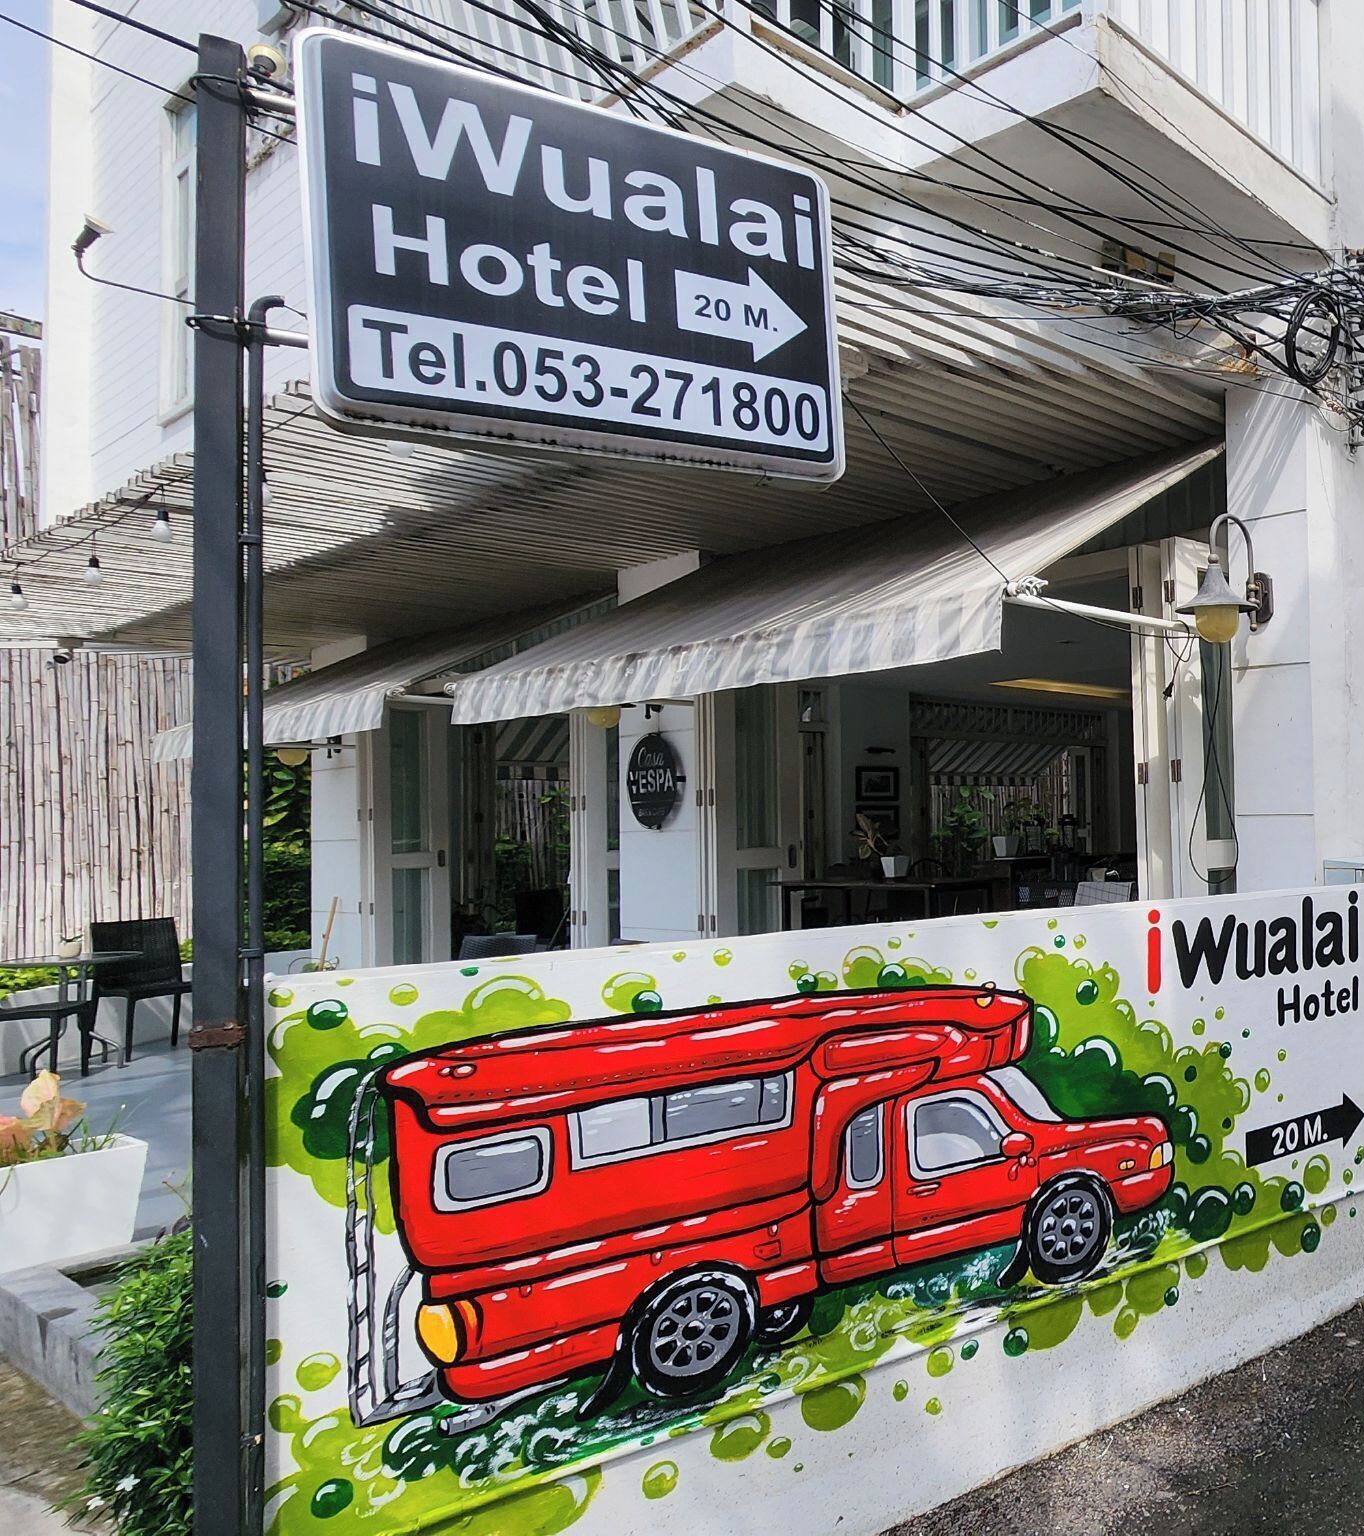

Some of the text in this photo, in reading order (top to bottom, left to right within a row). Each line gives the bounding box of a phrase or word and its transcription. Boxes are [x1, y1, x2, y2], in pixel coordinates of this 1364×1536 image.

[352, 72, 815, 270] iWualai
[372, 203, 647, 323] Hotel
[694, 294, 778, 332] 20 M.
[362, 318, 820, 442] Tel.053-271800
[638, 747, 665, 767] Casa
[629, 768, 675, 795] VESPA
[1277, 976, 1359, 1027] Hotel
[1271, 1114, 1329, 1156] 20 M.
